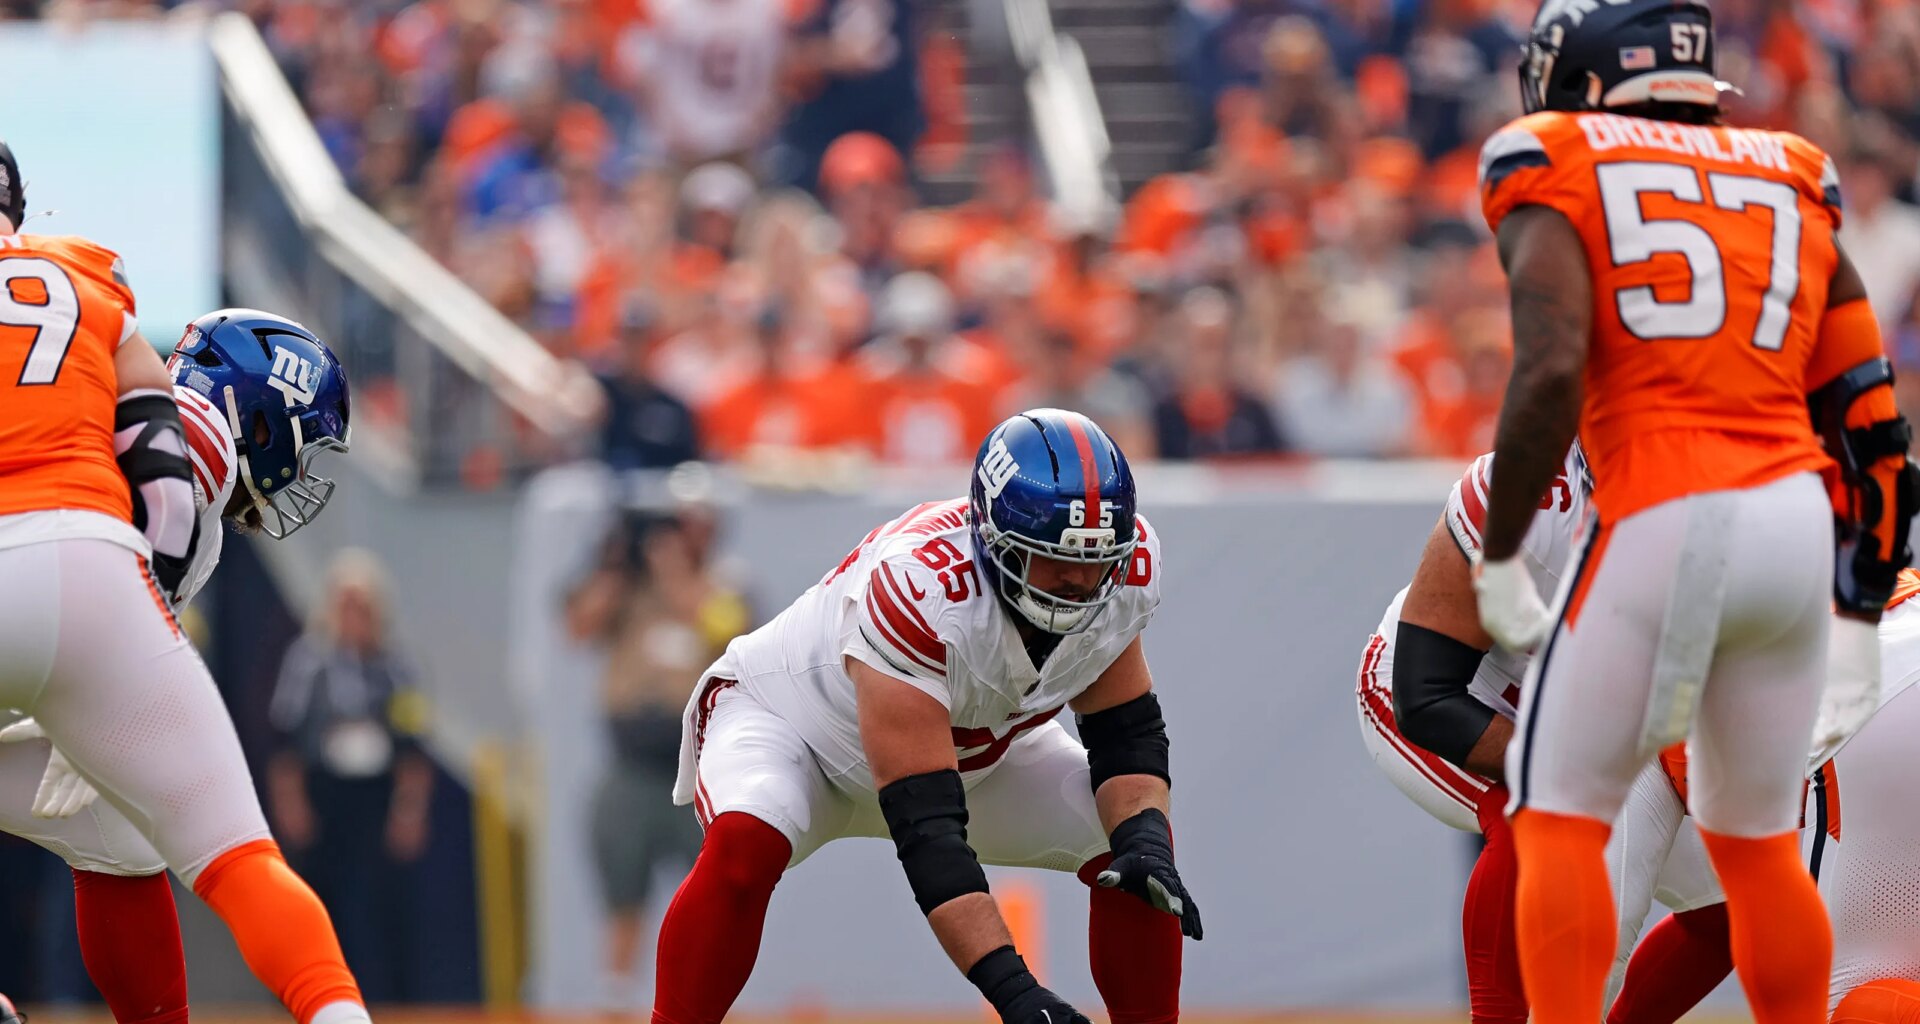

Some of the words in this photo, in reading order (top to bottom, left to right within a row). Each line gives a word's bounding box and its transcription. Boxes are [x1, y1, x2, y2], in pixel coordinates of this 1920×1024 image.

[1670, 22, 1707, 62] 57
[1577, 112, 1790, 173] GREENLAW
[1595, 161, 1801, 352] 57
[0, 257, 80, 386] 9
[911, 537, 982, 603] 65
